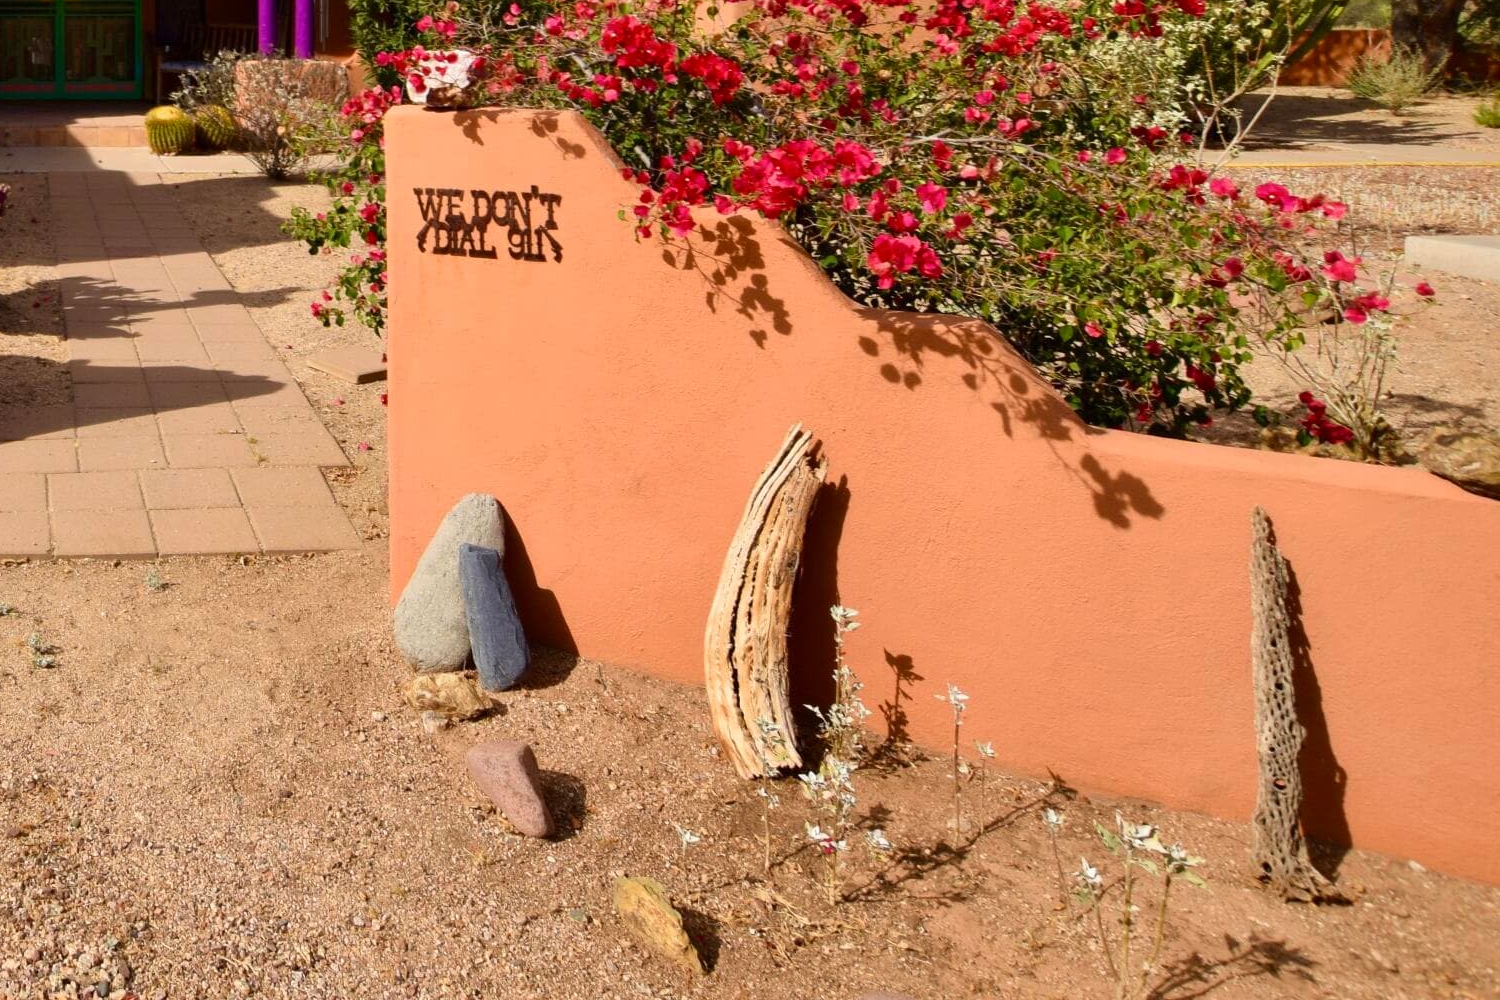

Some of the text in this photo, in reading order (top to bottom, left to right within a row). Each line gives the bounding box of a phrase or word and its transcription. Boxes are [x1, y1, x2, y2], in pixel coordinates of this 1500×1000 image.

[412, 185, 562, 230] WE DON'T
[433, 219, 547, 262] DIAL 911
